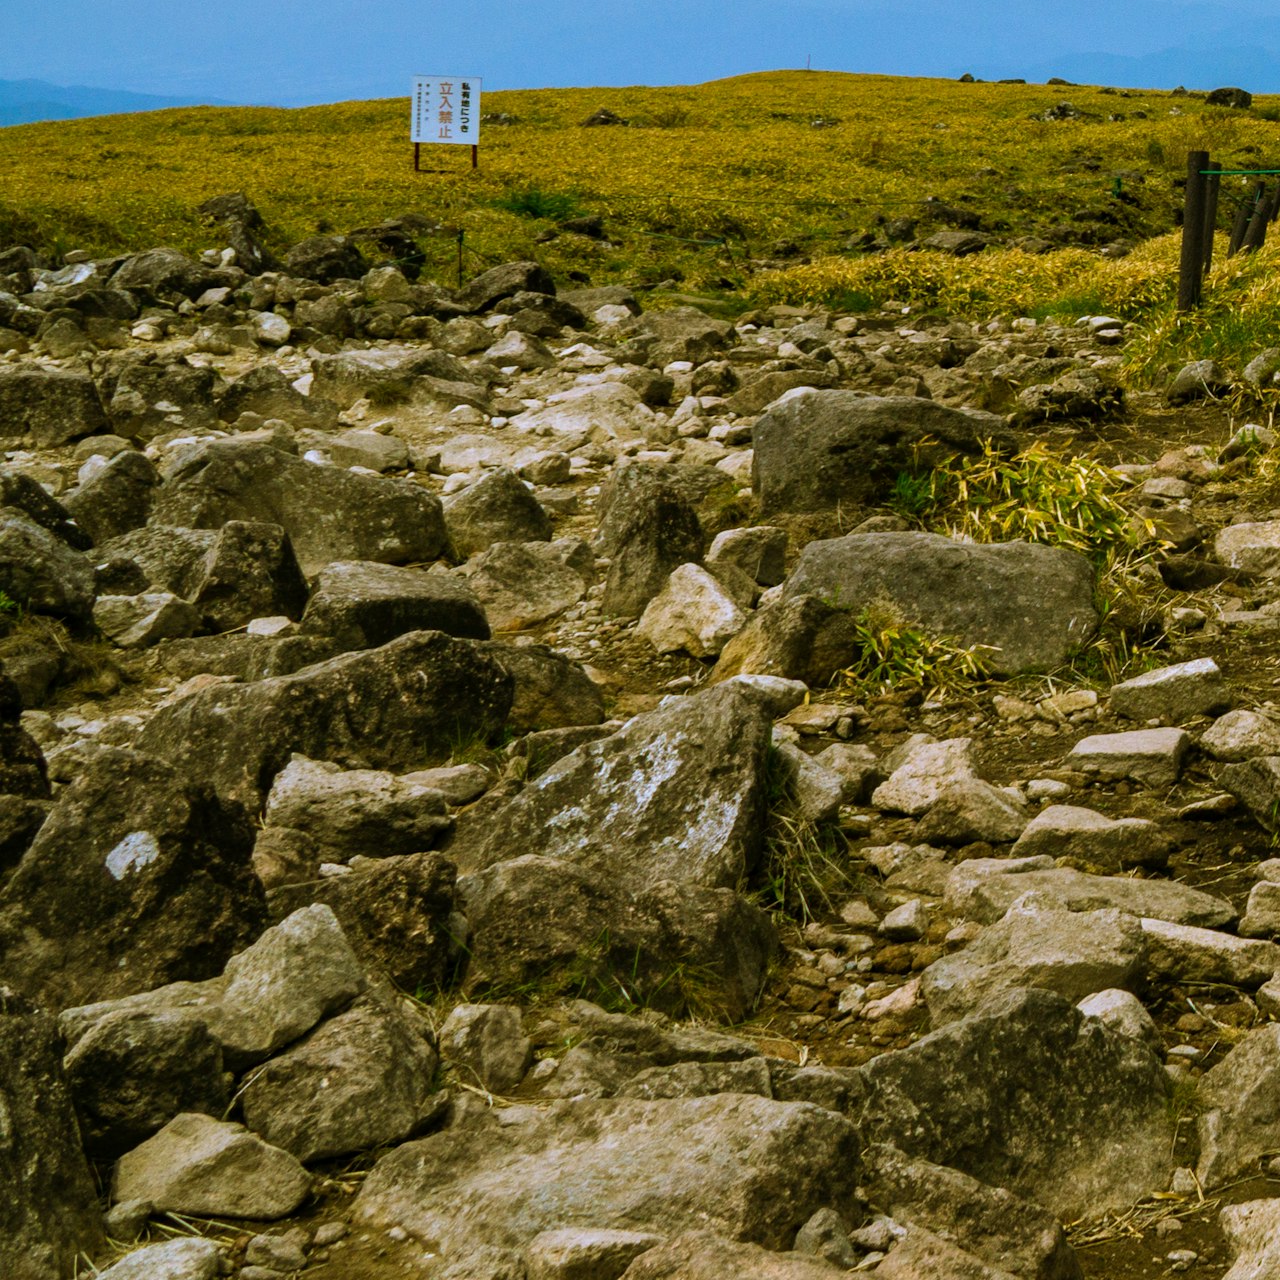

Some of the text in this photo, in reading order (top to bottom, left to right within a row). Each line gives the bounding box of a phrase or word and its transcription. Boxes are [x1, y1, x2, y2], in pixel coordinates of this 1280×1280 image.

[438, 82, 453, 138] 立入禁止
[460, 82, 471, 133] 私有地につき
